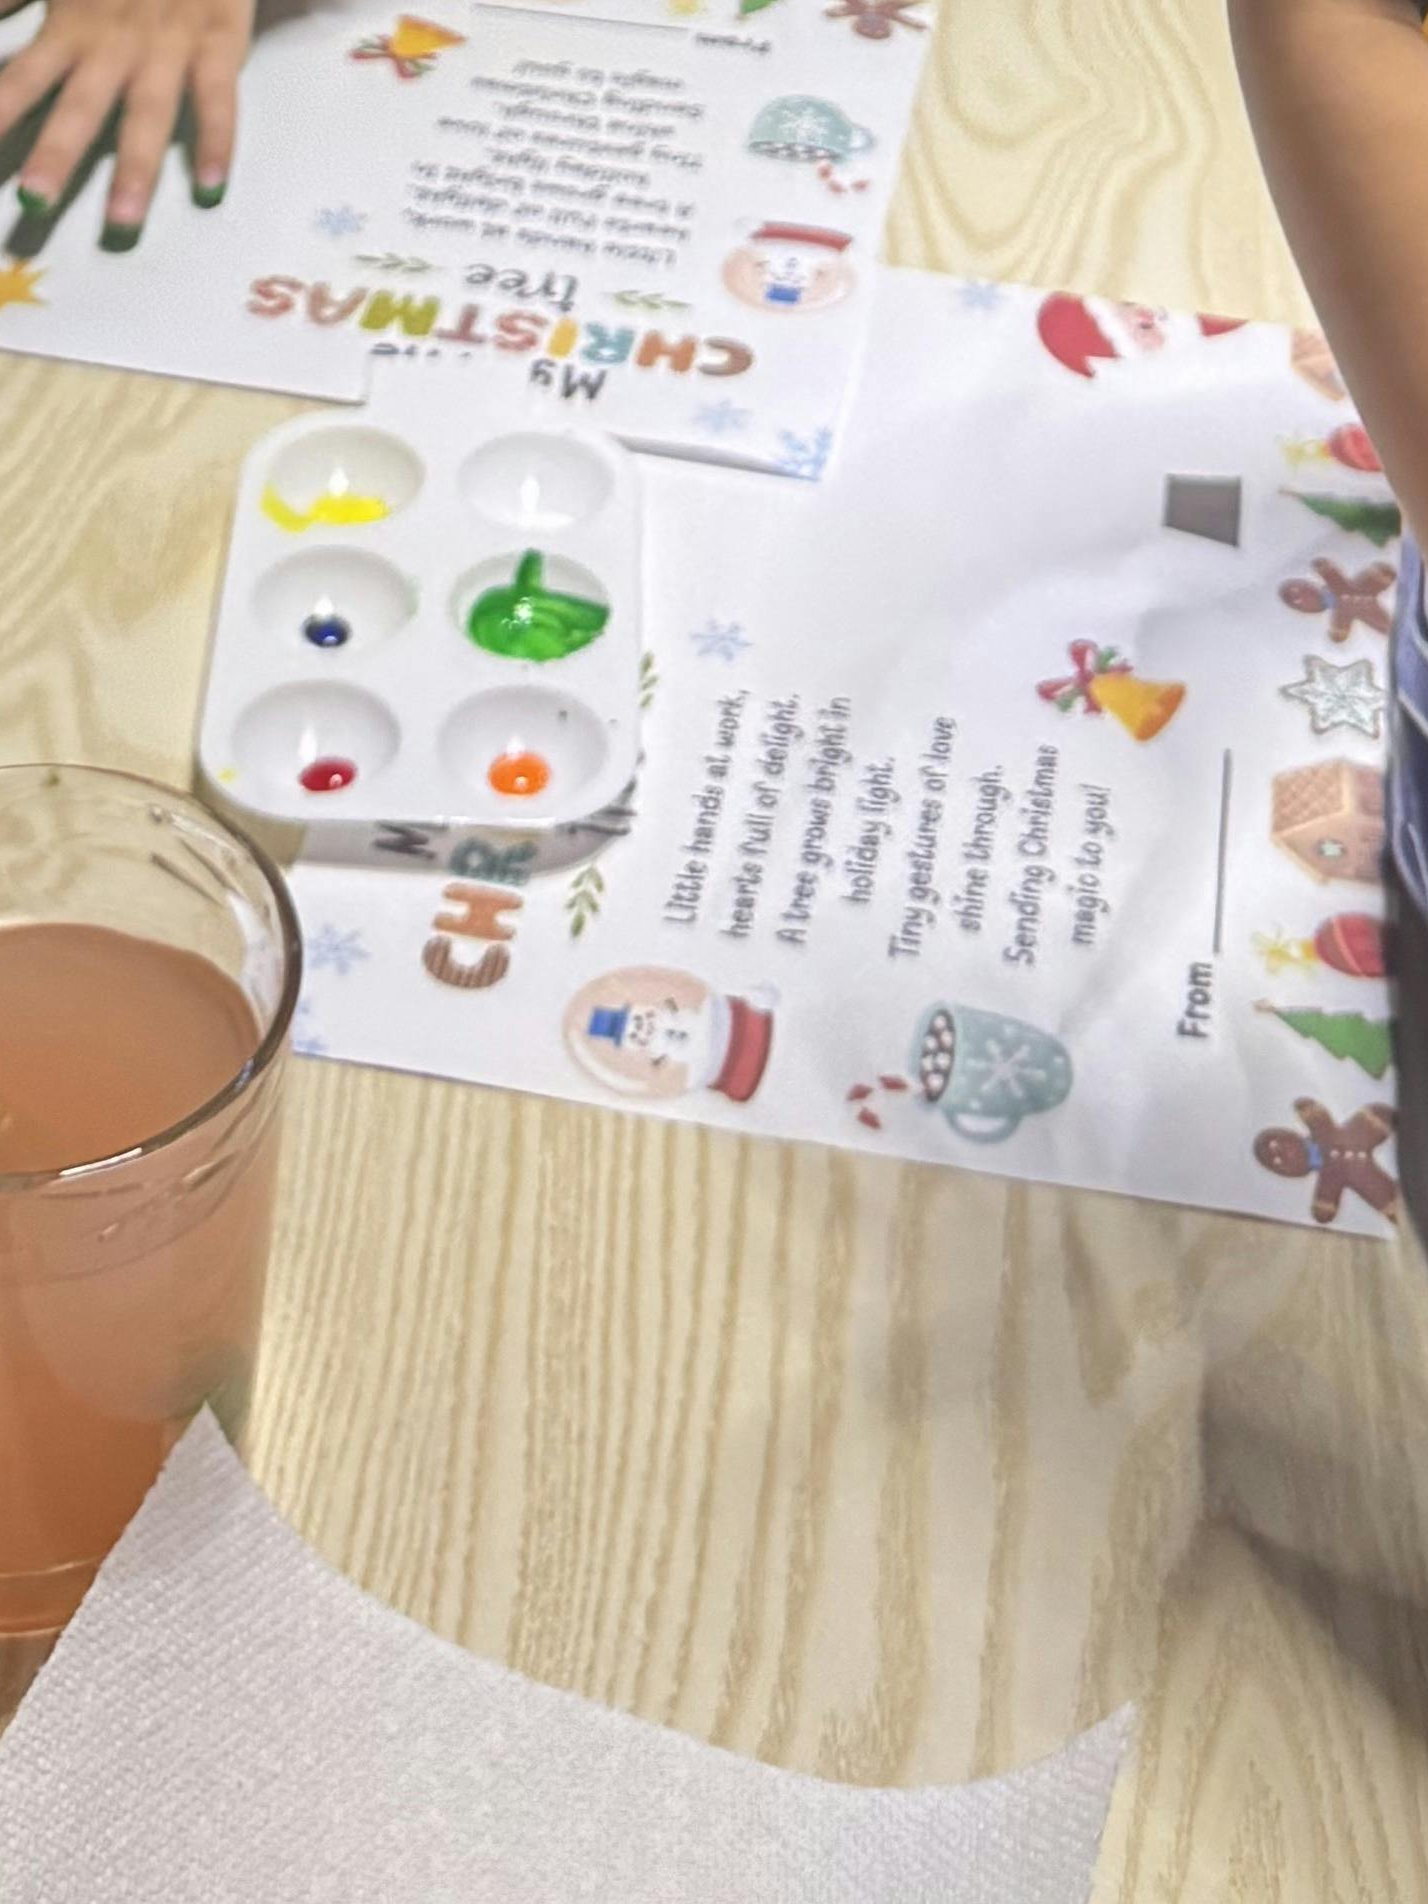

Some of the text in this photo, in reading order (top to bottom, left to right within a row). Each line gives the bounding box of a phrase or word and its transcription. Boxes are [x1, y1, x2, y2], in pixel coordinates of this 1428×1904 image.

[246, 276, 754, 378] CHRISTMAS
[465, 264, 577, 315] tree
[529, 359, 607, 401] My
[663, 689, 750, 925] Little hands at work,
[719, 693, 803, 939] hearts full of delight.
[774, 697, 852, 945] A tree grows bright in
[841, 756, 901, 905] holiday light.
[887, 716, 957, 961] Tiny gestures of love
[952, 765, 1010, 932] shine through.
[1002, 743, 1058, 966] Sending Christmas
[1066, 783, 1114, 946] magic to you!
[1176, 962, 1212, 1040] From
